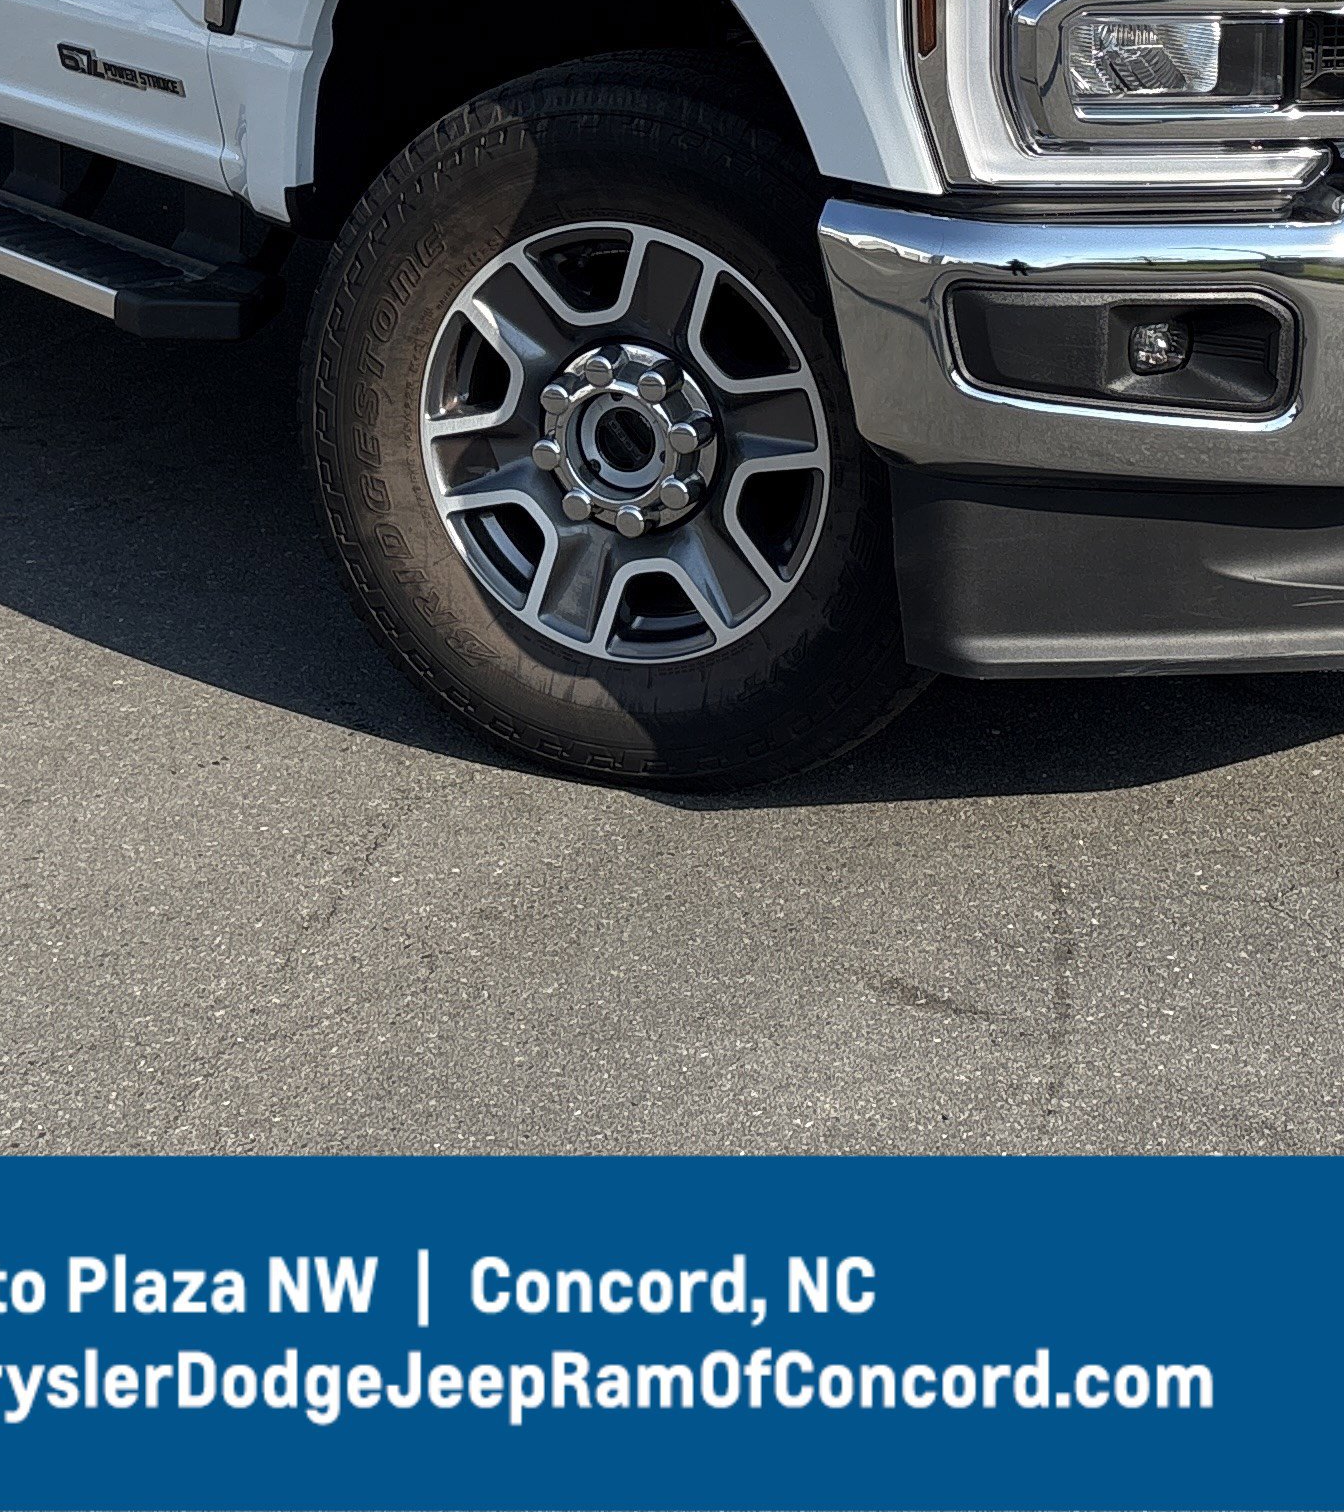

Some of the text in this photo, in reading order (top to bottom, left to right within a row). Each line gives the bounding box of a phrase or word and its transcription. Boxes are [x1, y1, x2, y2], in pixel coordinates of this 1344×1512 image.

[102, 61, 138, 84] POWER
[138, 70, 181, 95] STROKE
[353, 223, 503, 660] BRIDGESTONE
